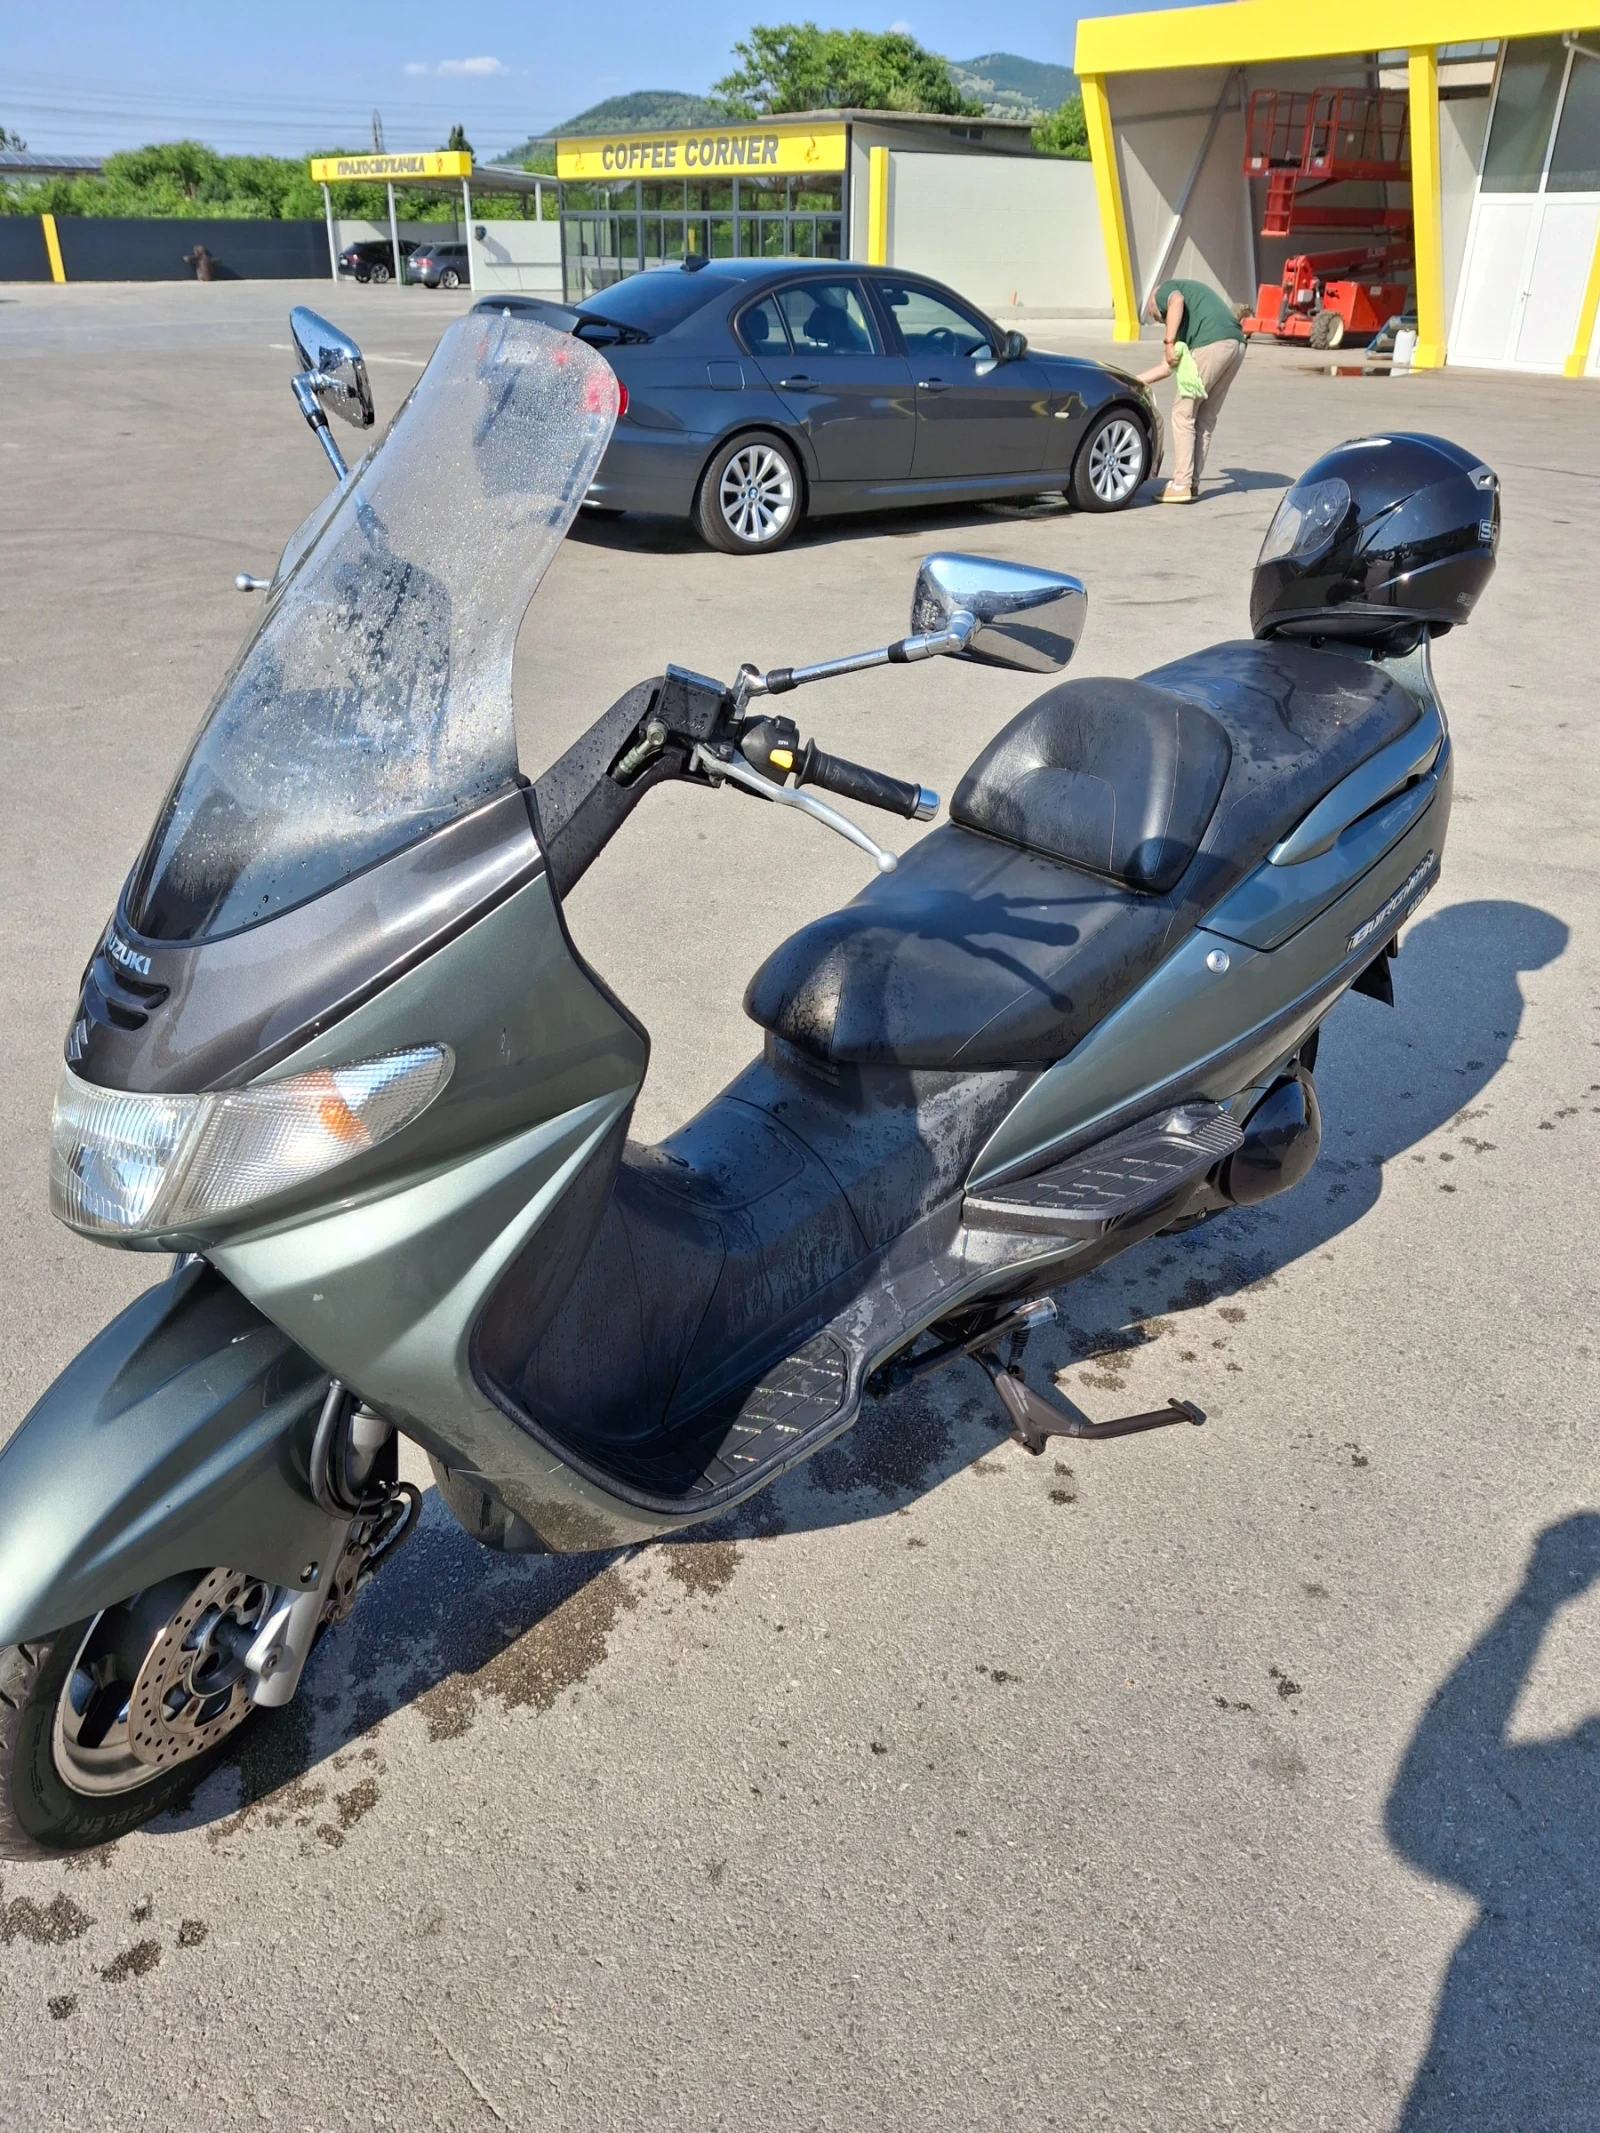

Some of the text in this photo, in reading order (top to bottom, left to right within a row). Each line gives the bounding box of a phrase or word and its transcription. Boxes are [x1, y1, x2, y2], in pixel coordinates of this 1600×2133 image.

[337, 156, 425, 176] ПРАХОСМУКАЧКА
[602, 134, 779, 170] COFFEE CORNER
